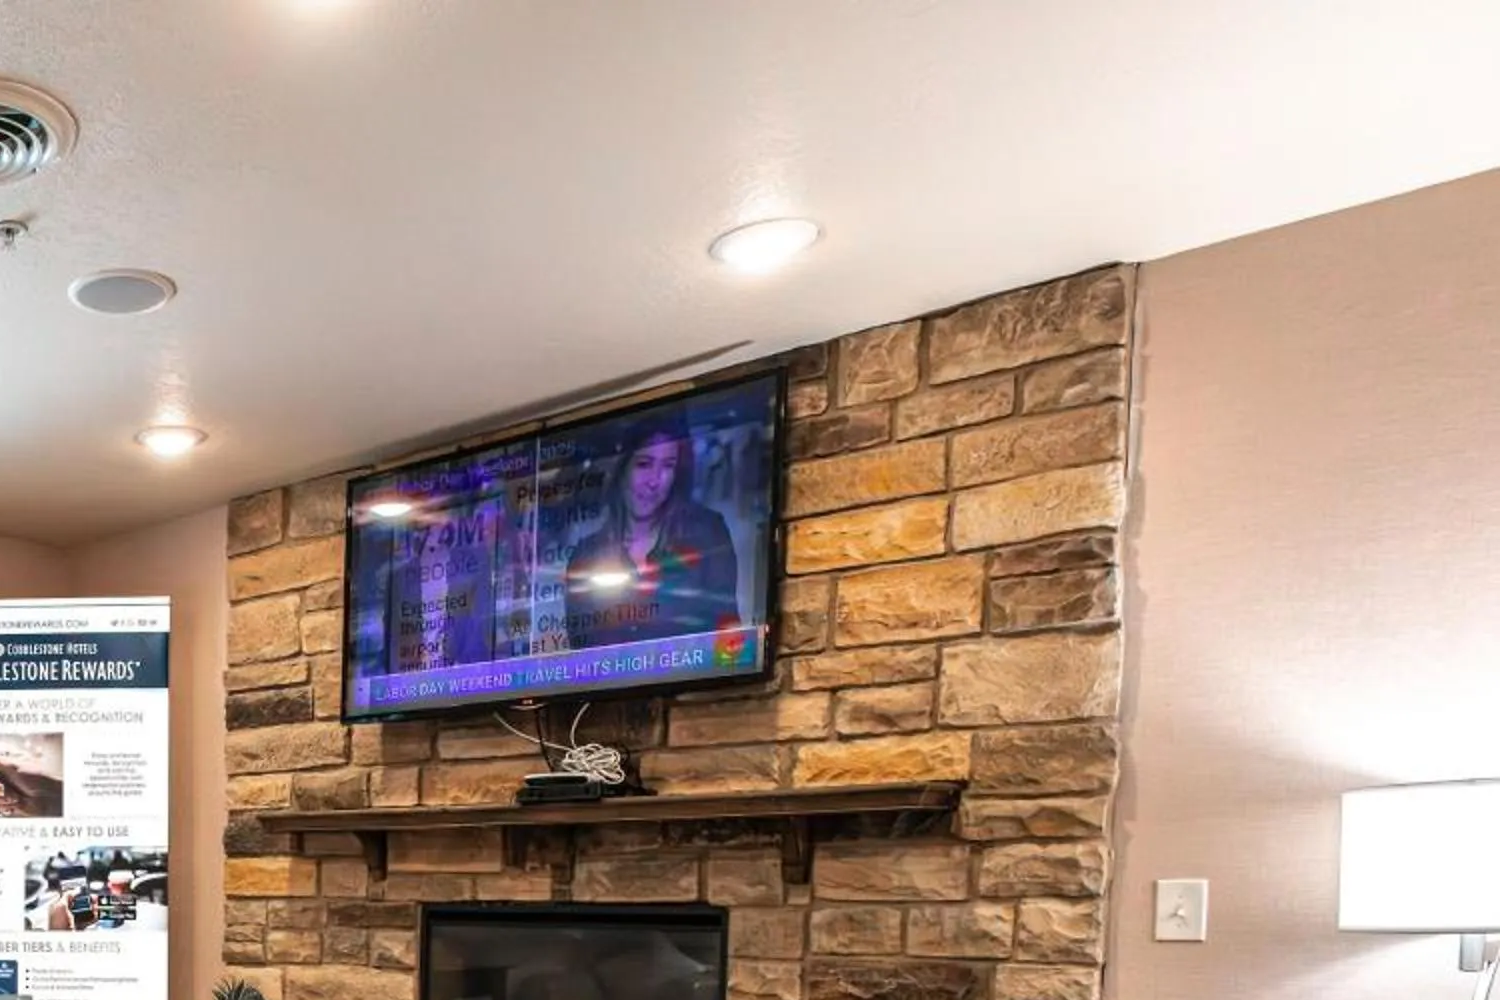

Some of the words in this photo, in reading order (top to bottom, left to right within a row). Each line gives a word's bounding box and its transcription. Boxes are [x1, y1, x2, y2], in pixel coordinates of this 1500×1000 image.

[401, 591, 467, 617] Expected
[537, 607, 610, 633] Cheaper
[616, 601, 660, 622] Than
[375, 684, 417, 701] LABOR
[419, 681, 445, 696] DAY
[449, 673, 512, 692] WEEKEND
[517, 664, 570, 686] TRAVEL
[575, 660, 610, 678] HITS
[615, 654, 652, 672] HIGH
[659, 649, 704, 669] GEAR
[15, 700, 25, 710] A
[28, 699, 75, 711] WORLD
[79, 698, 97, 709] OF
[41, 713, 50, 723] &
[55, 711, 144, 724] RECOGNITION
[40, 827, 49, 838] &
[53, 826, 82, 838] EASY
[87, 826, 103, 837] TO
[108, 825, 129, 837] USE
[22, 942, 53, 953] TIERS
[56, 942, 66, 953] &
[69, 942, 121, 953] BENEFITS
